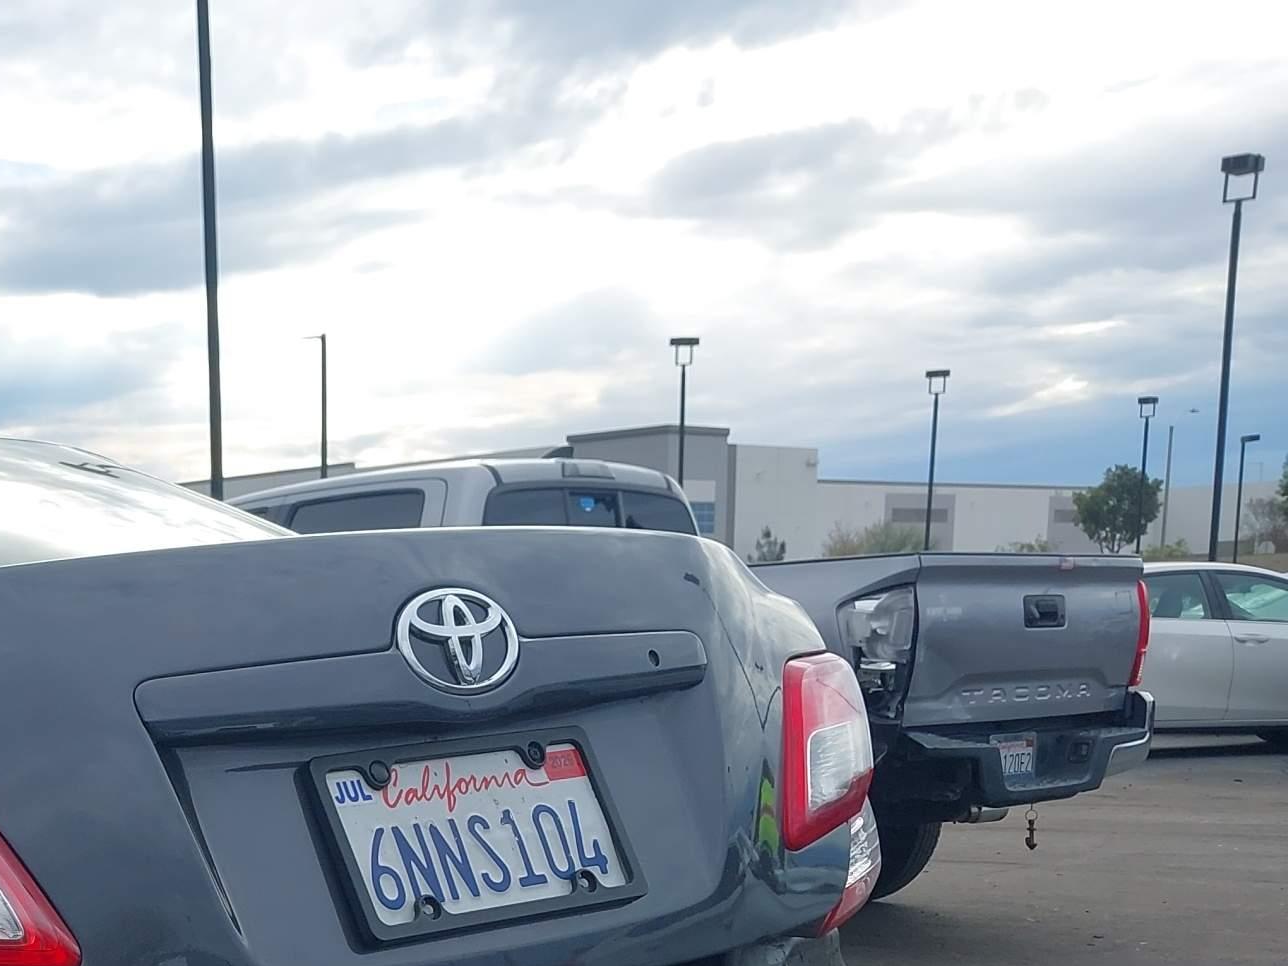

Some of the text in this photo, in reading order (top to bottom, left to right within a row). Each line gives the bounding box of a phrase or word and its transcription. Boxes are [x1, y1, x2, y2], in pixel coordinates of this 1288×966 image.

[961, 682, 1092, 704] TACOMA
[334, 779, 373, 805] JUL
[381, 761, 550, 812] California
[370, 800, 609, 910] 6NNS104
